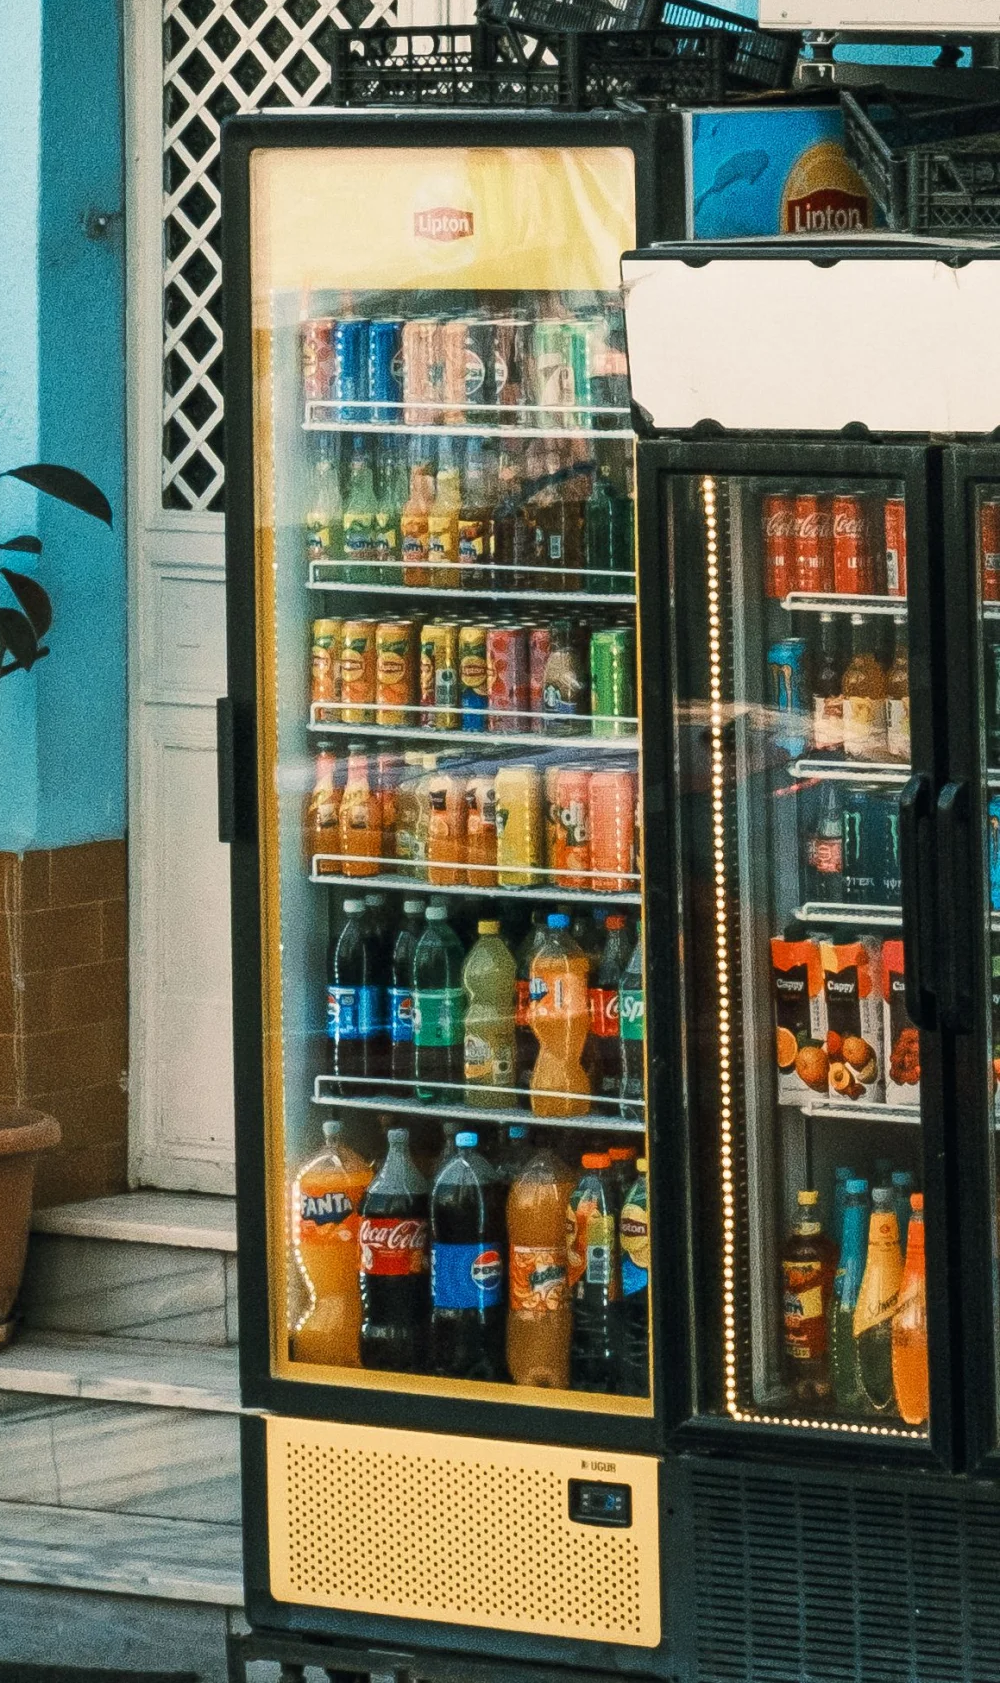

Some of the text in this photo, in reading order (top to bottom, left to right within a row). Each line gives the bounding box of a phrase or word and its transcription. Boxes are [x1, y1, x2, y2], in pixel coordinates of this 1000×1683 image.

[419, 215, 470, 235] Lipton
[795, 203, 863, 233] Lipton
[776, 979, 804, 991] Cappy
[827, 980, 855, 993] Cappy
